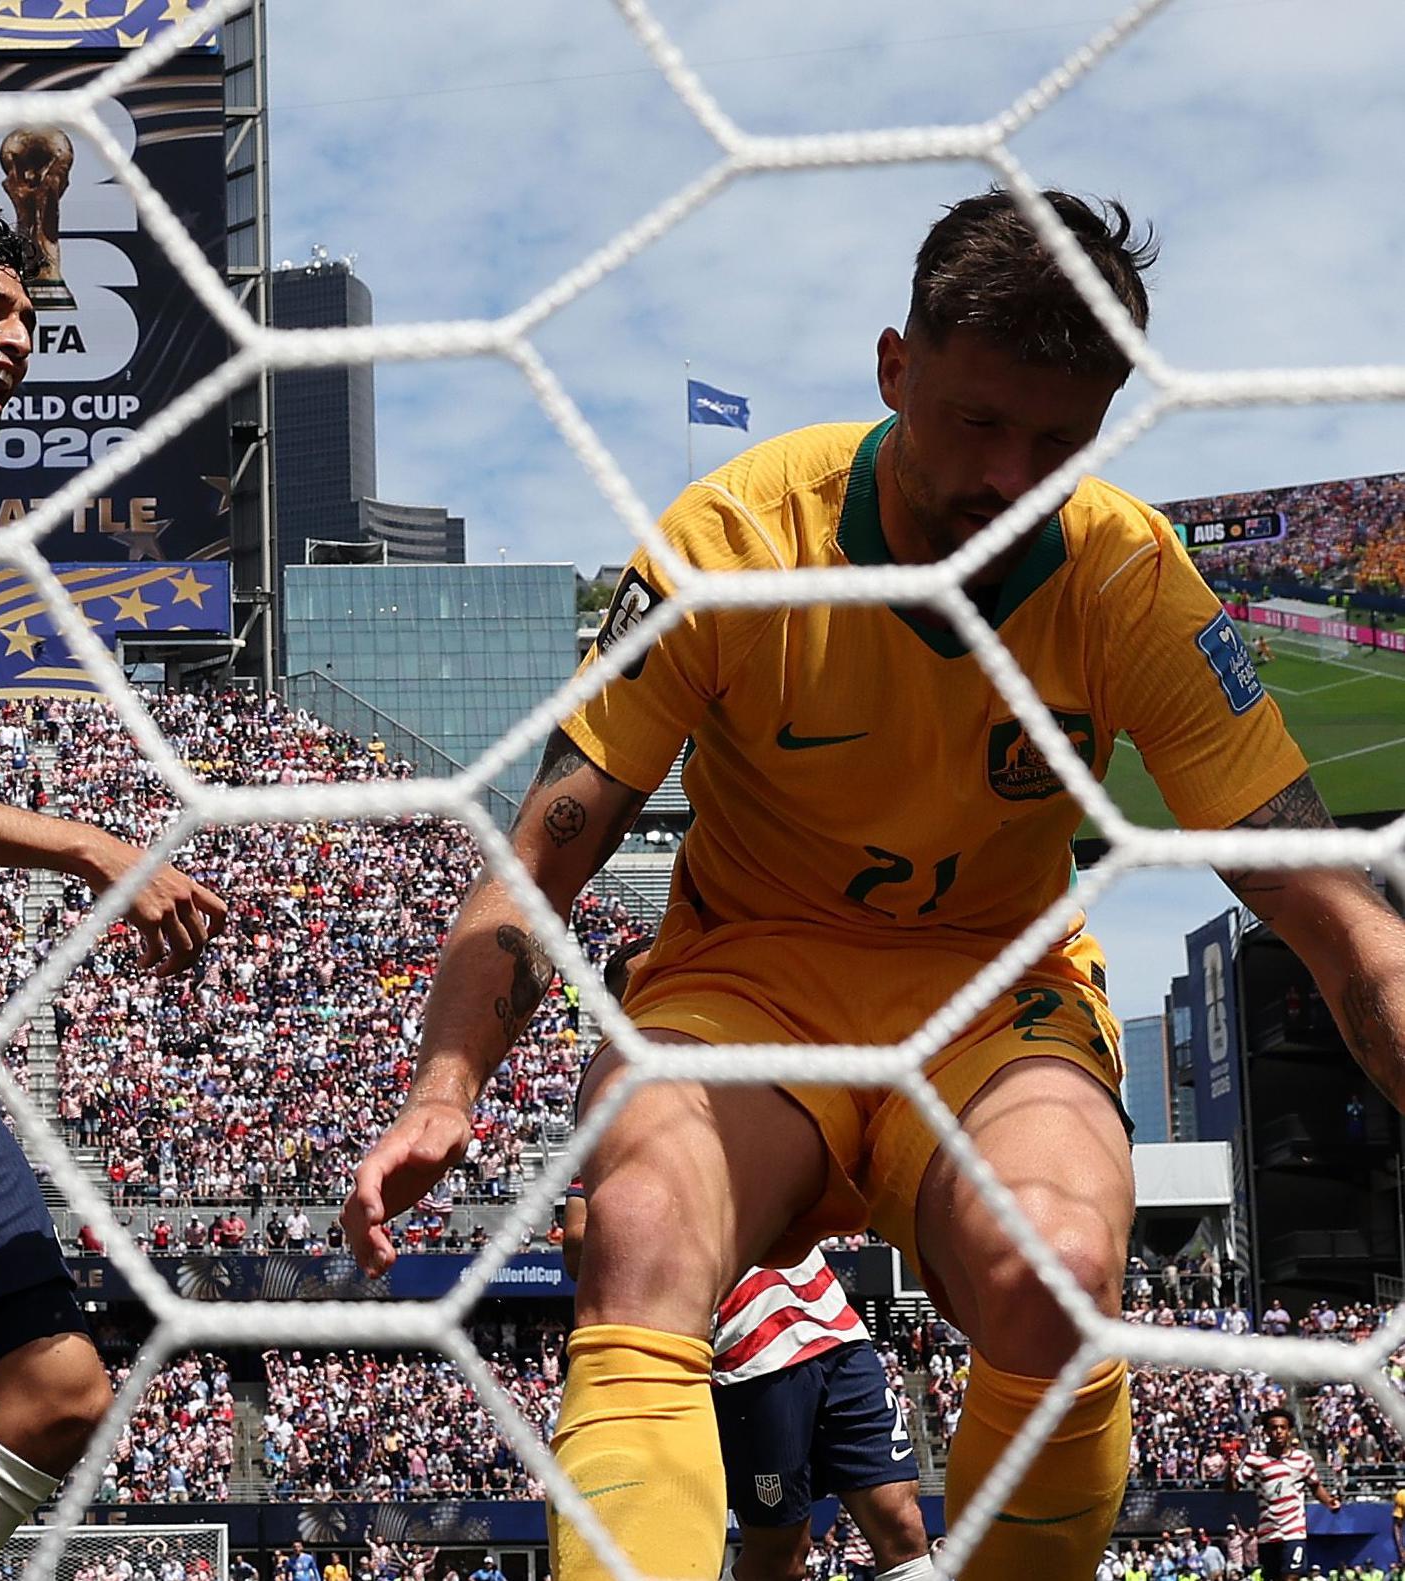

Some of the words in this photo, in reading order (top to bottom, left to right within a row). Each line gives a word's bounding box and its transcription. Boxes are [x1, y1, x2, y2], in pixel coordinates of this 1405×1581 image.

[0, 395, 66, 420] RLD
[72, 395, 140, 420] CUP
[1193, 523, 1226, 544] AUS
[845, 844, 962, 920] 21
[757, 1476, 779, 1489] USA
